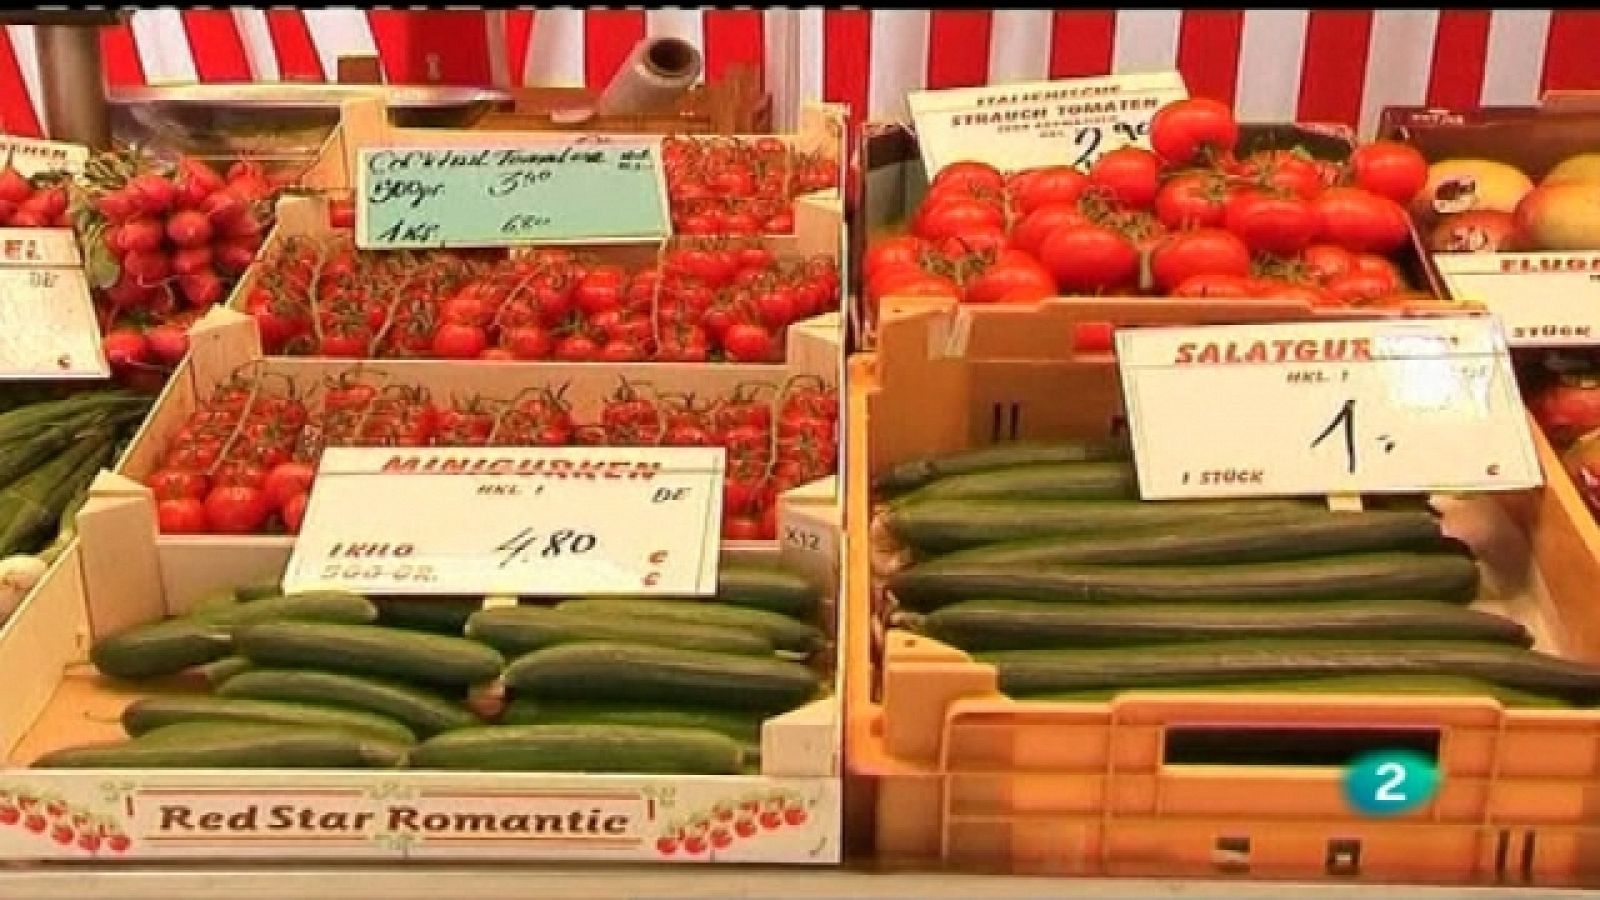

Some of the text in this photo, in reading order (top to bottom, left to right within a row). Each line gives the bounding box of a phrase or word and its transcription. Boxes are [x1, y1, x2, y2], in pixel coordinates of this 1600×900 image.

[951, 108, 1048, 126] STRAUCH
[1058, 97, 1159, 117] TOMATEN
[1175, 337, 1460, 364] SALATGUR
[159, 805, 630, 834] Red Star Romantic
